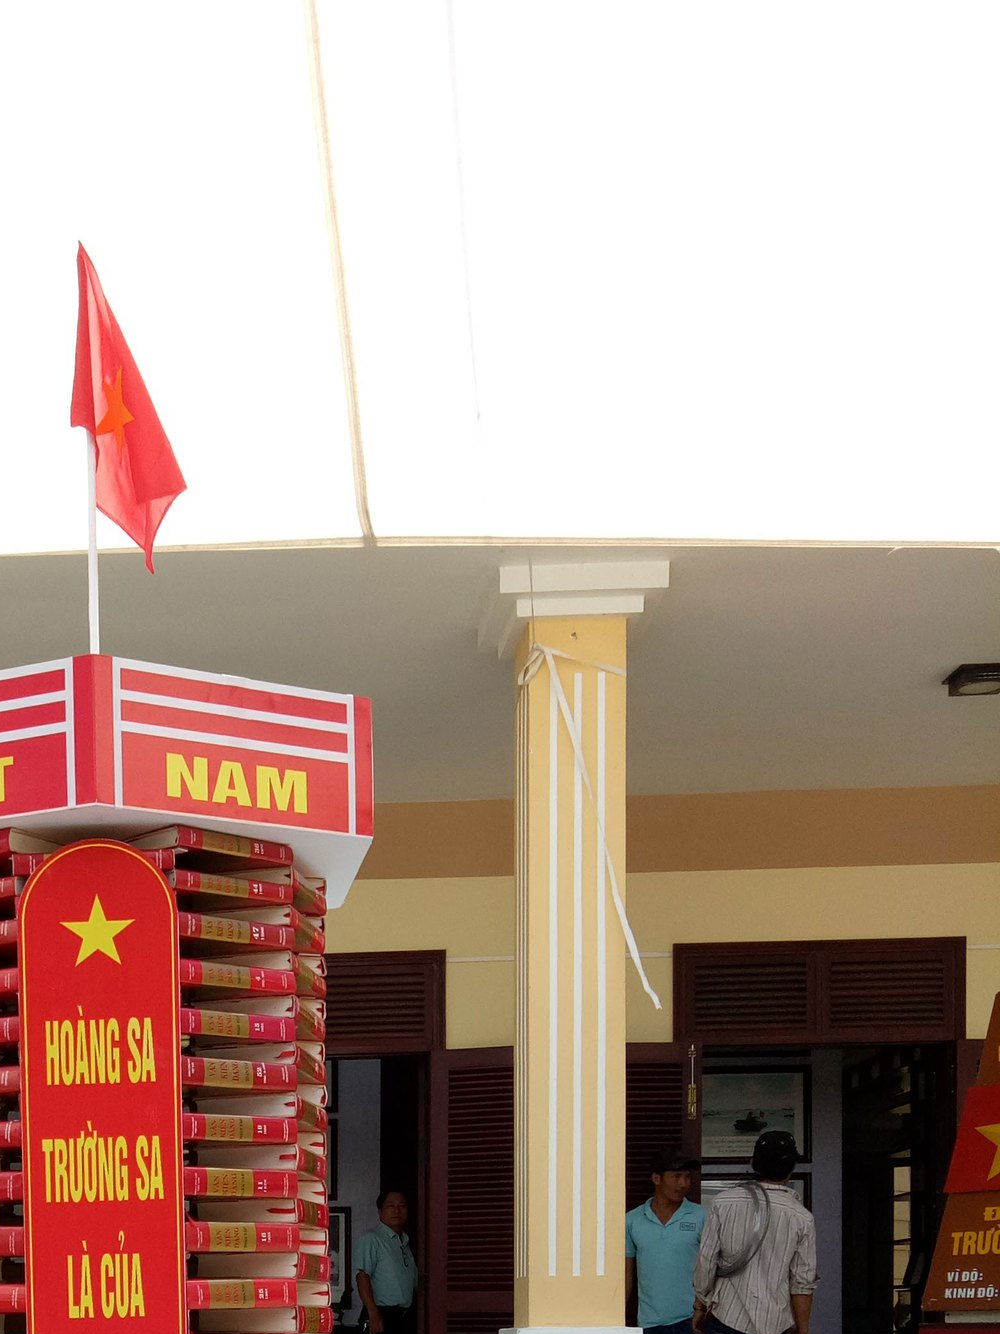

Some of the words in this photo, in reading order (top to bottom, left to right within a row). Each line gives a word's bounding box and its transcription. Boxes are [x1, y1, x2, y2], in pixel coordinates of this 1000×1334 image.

[166, 753, 308, 814] NAM
[252, 926, 260, 940] 47
[255, 1022, 260, 1031] 15
[45, 1005, 120, 1086] HOÀNG
[127, 1017, 156, 1084] SA
[42, 1120, 128, 1204] TRƯỜNG
[135, 1135, 164, 1202] SA
[257, 1181, 263, 1191] 11
[67, 1241, 94, 1319] LÀ
[100, 1230, 145, 1319] CỦA
[961, 1268, 983, 1284] ĐỘ:
[258, 1288, 265, 1299] 25
[944, 1287, 975, 1299] KINH
[976, 1284, 999, 1301] ĐỘ:
